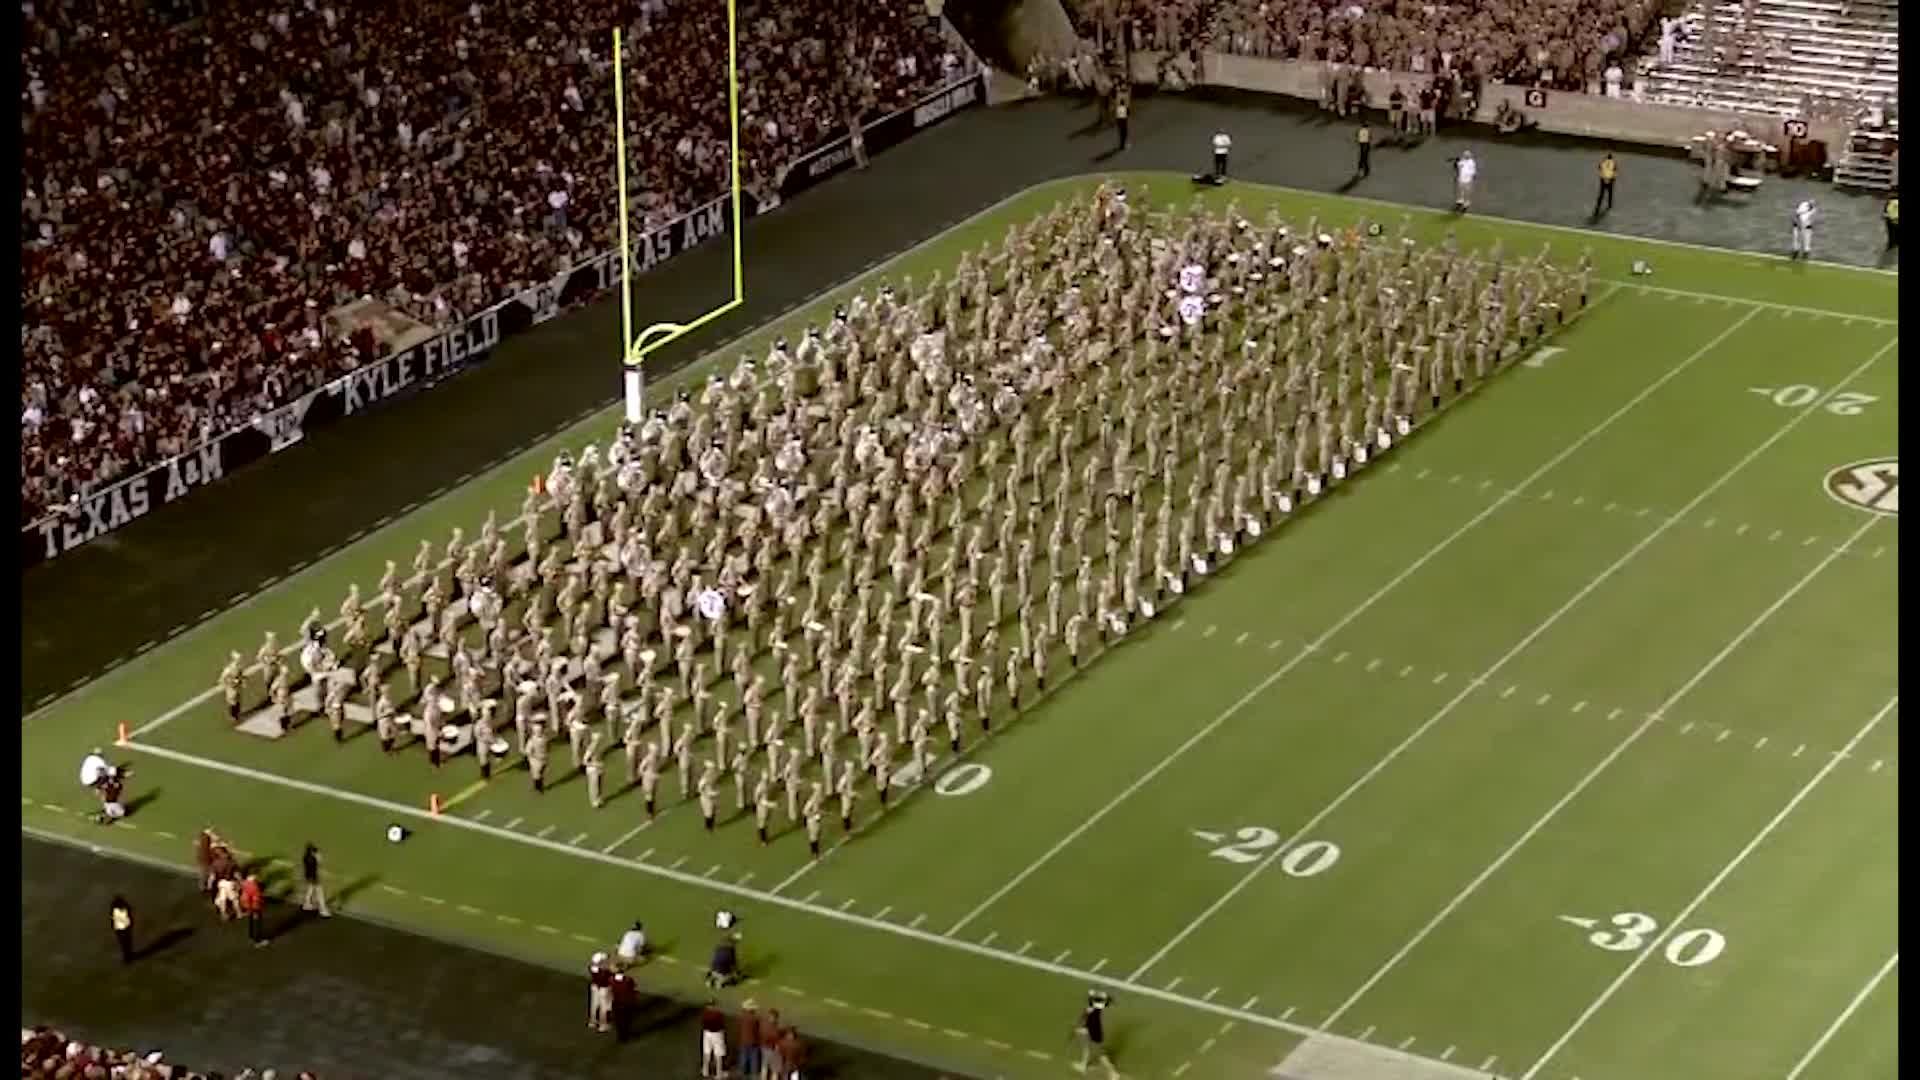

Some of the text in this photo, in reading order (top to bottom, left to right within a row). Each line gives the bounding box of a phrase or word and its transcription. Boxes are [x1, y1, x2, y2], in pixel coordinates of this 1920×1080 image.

[593, 202, 725, 290] TEXAS A&M
[344, 310, 499, 415] KYLE FIELD
[1772, 384, 1880, 416] 20
[39, 443, 224, 559] TEXAS A&M
[1208, 826, 1341, 877] 20
[1589, 912, 1726, 967] 30
